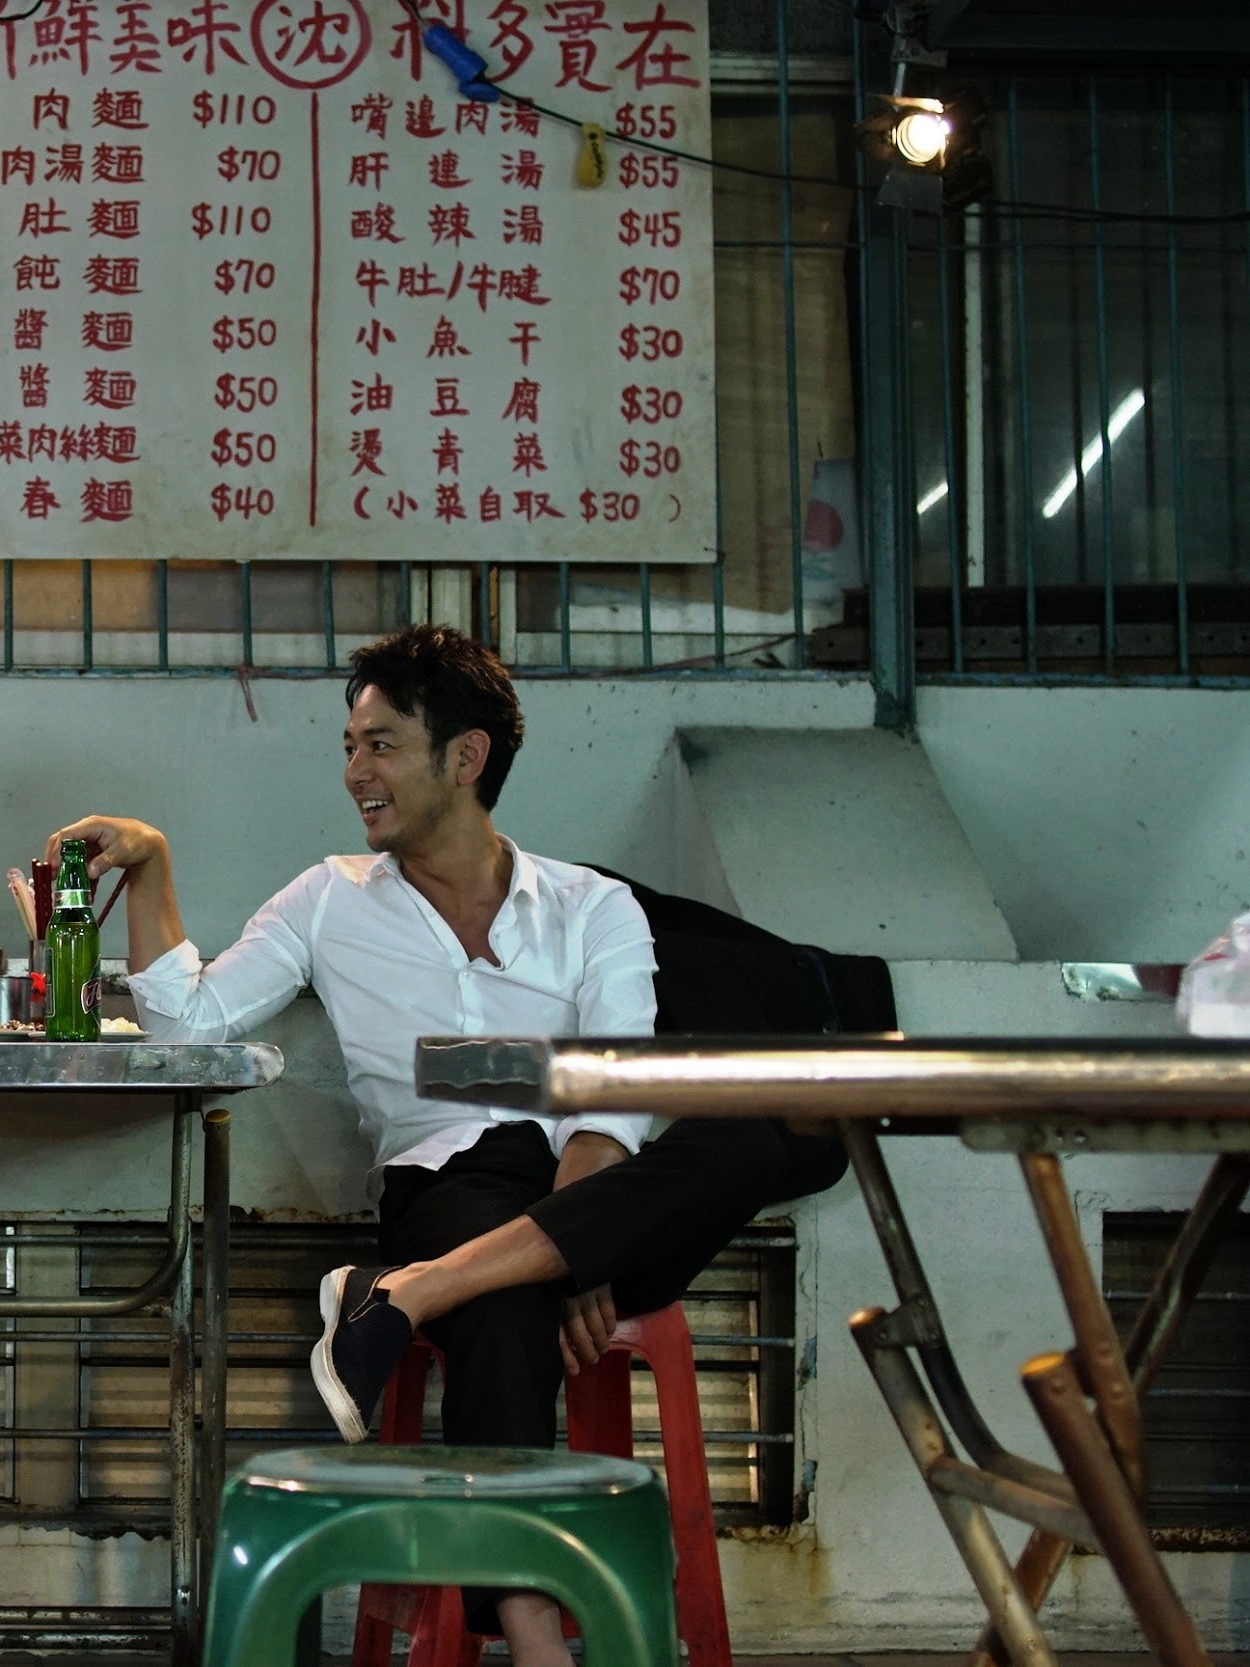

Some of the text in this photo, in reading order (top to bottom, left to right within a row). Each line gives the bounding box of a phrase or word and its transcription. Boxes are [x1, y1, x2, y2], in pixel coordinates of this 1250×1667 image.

[274, 1, 352, 67] 沈
[192, 92, 277, 128] $110
[616, 102, 677, 139] $55
[217, 146, 281, 182] $70
[350, 150, 544, 190] 肝連湯
[619, 152, 680, 189] $55
[191, 202, 271, 239] $110
[350, 203, 682, 248] 酸辣湯 $45
[214, 259, 276, 295] $70
[620, 265, 680, 305] $70
[212, 315, 277, 353] $50
[356, 314, 684, 366] 小魚干 $30
[214, 373, 278, 413] $50
[350, 372, 683, 424] 油豆腐 $30
[211, 427, 277, 467] $50
[350, 427, 681, 478] 燙青菜 $30
[211, 483, 275, 521] $40
